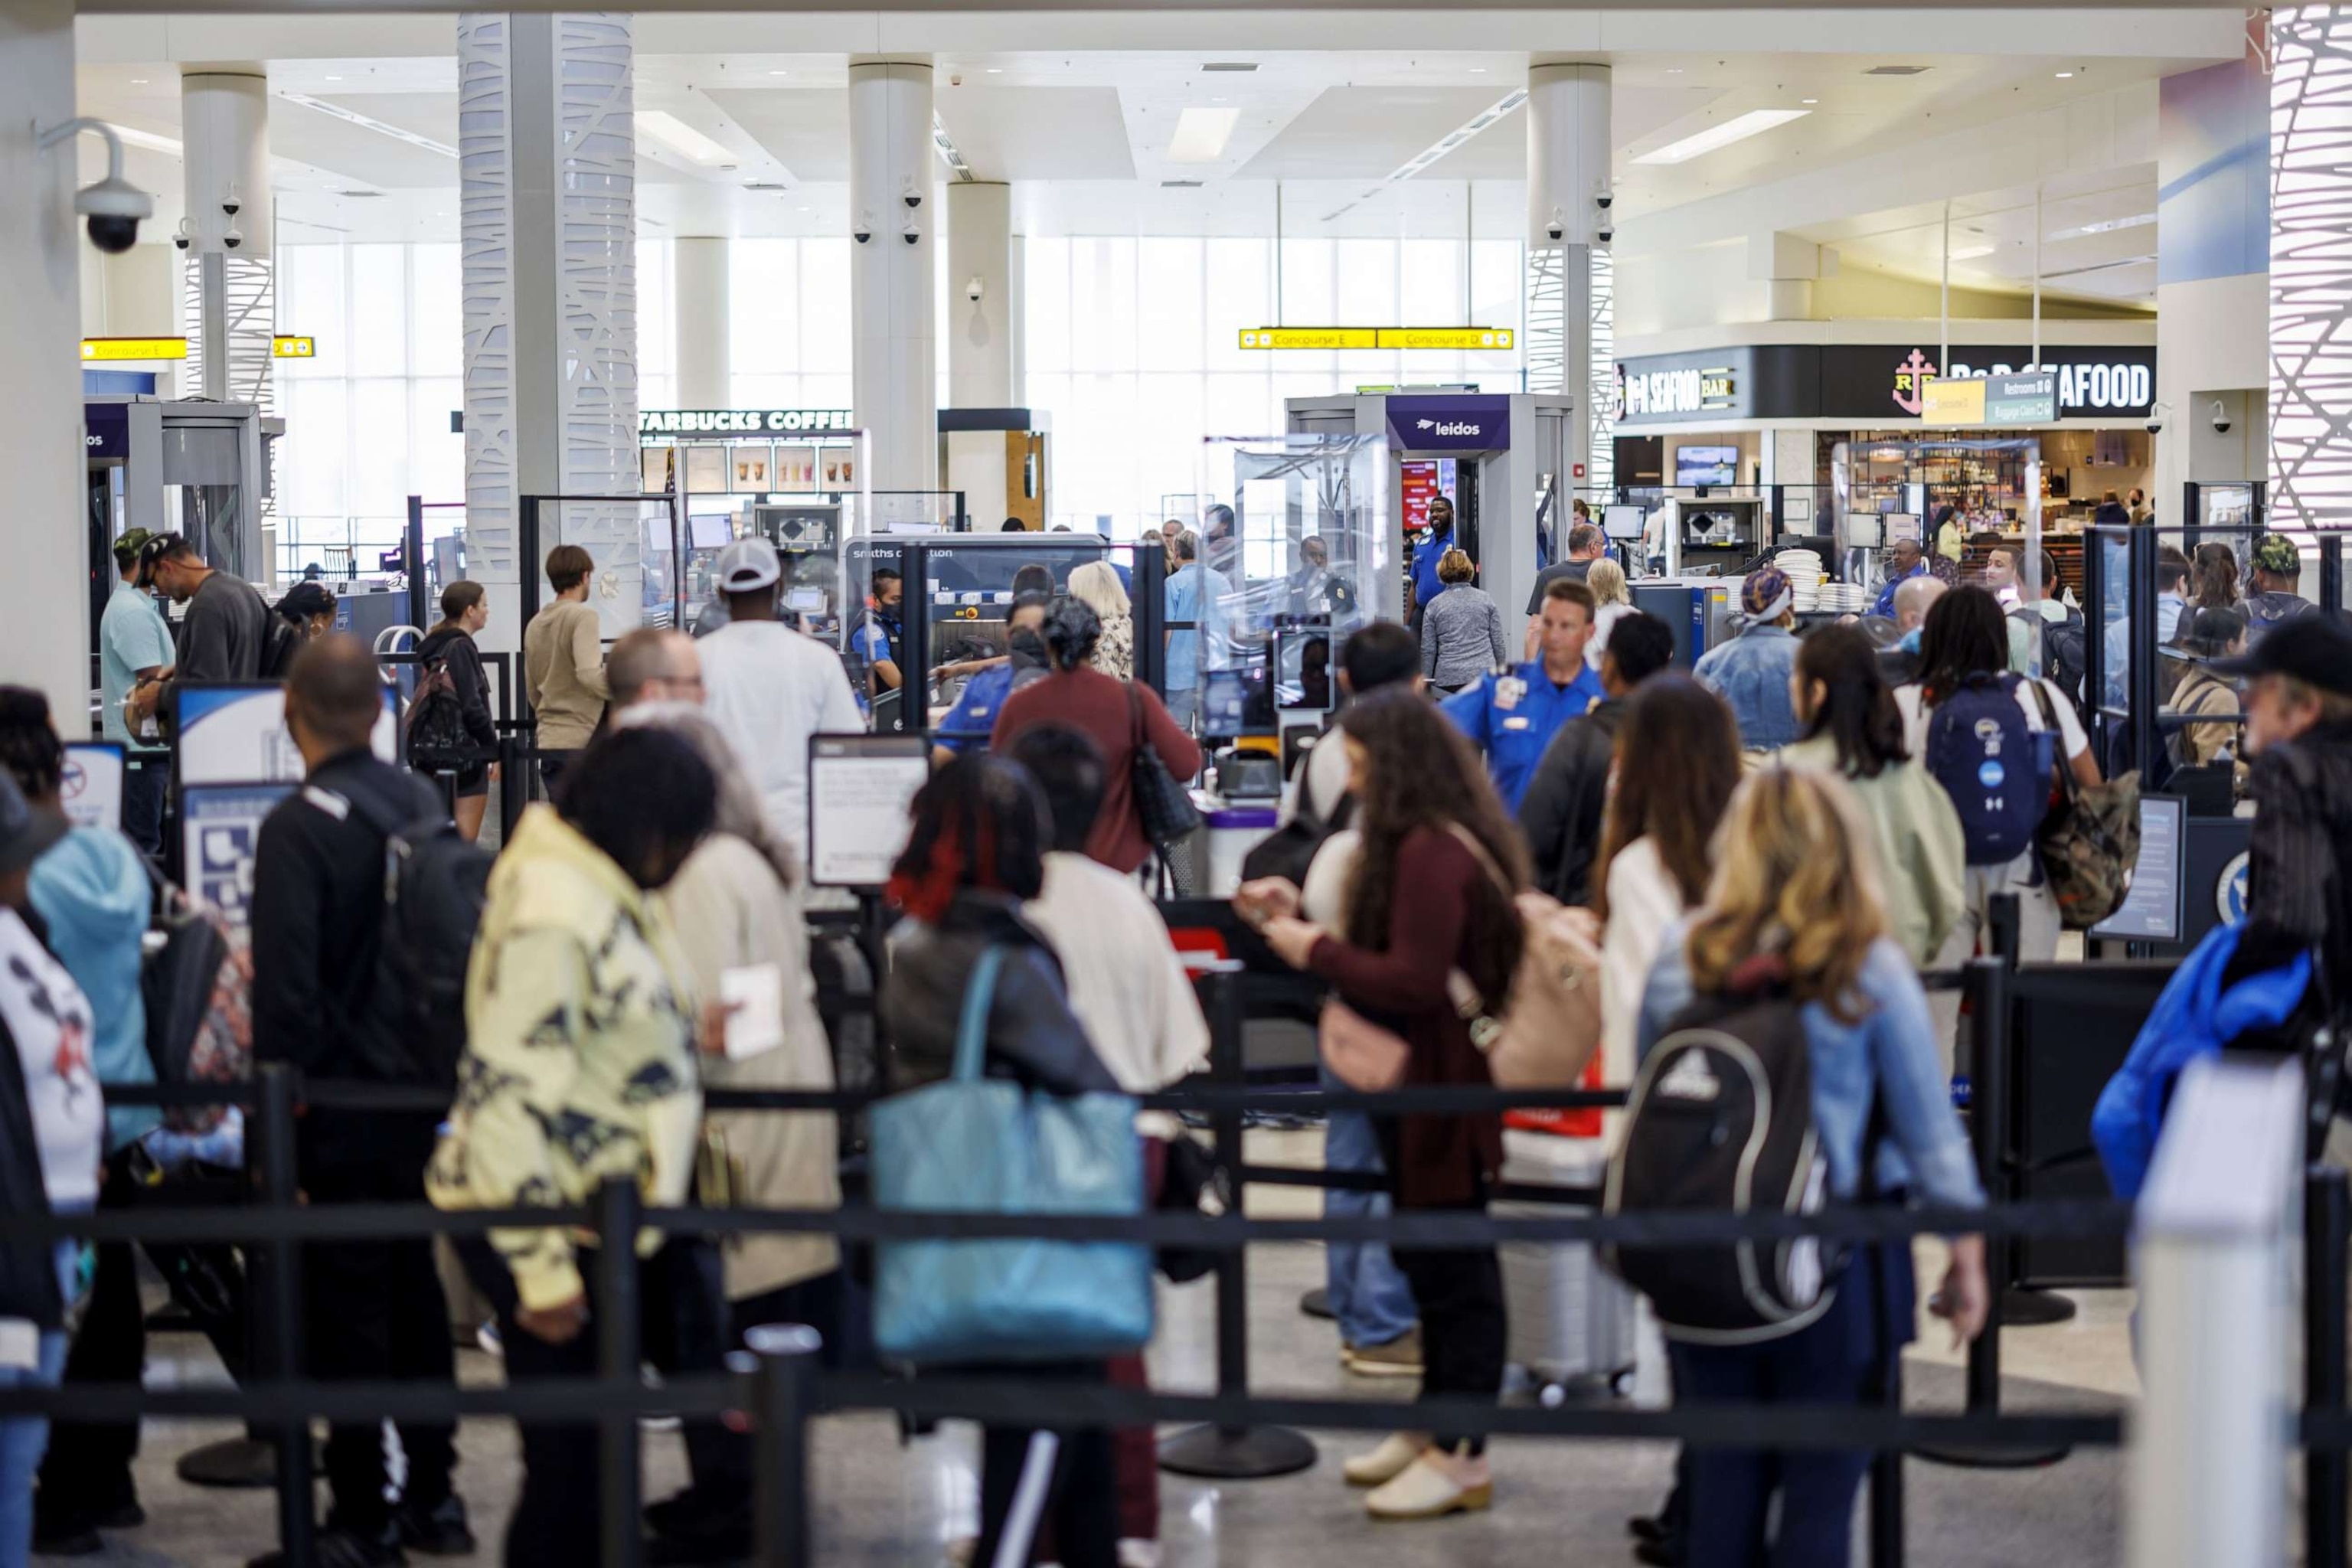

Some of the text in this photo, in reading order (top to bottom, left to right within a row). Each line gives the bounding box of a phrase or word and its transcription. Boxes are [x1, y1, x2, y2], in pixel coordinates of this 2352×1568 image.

[1274, 334, 1345, 345] Concourse E
[1406, 334, 1478, 345] Concourse D
[96, 345, 160, 356] Concourse E
[1650, 369, 1700, 413] SEAFOOD
[1701, 379, 1733, 397] BAR
[2004, 382, 2036, 395] Restrooms
[639, 412, 762, 430] TARBUCKS
[1436, 421, 1480, 436] leidos
